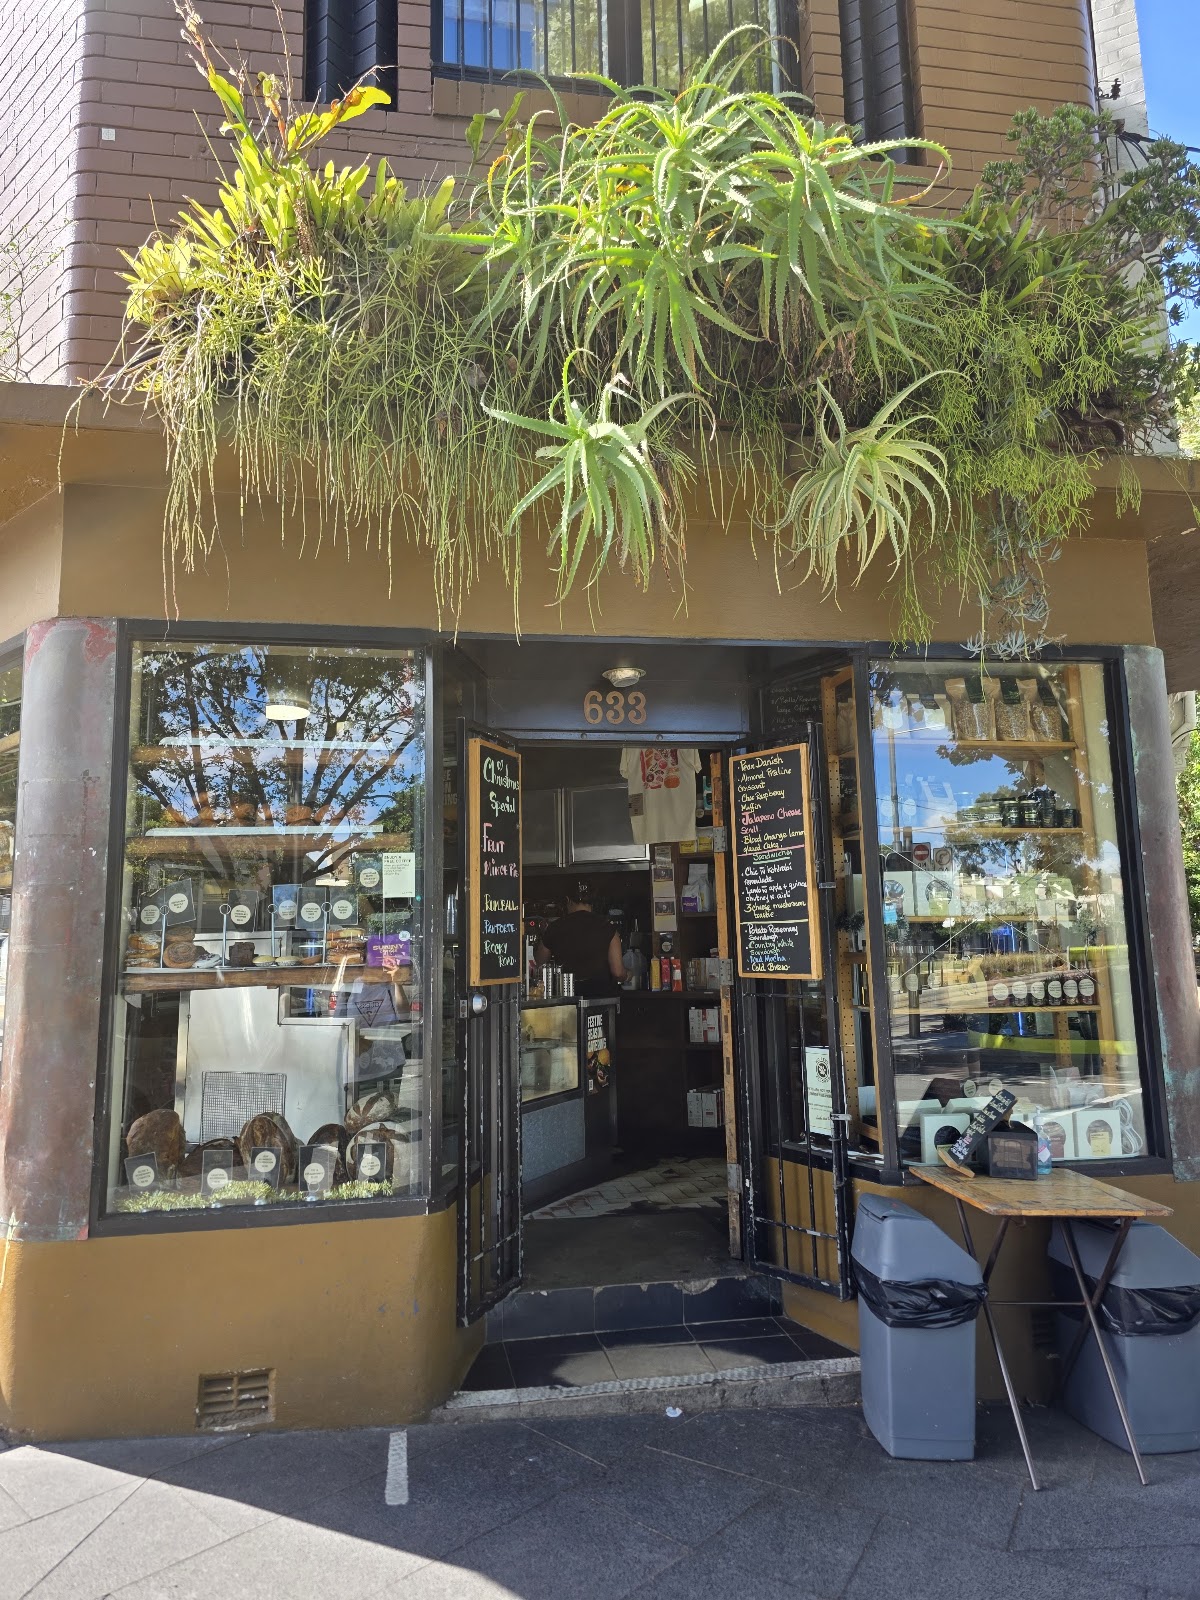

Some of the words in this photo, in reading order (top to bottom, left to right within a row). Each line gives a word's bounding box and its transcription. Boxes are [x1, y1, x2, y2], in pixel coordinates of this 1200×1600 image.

[583, 690, 647, 725] 633
[755, 753, 784, 768] Danish
[740, 770, 766, 783] Almond
[766, 766, 792, 777] Praline
[777, 807, 803, 820] Cheese
[742, 833, 763, 845] Blood
[763, 832, 788, 842] Orange
